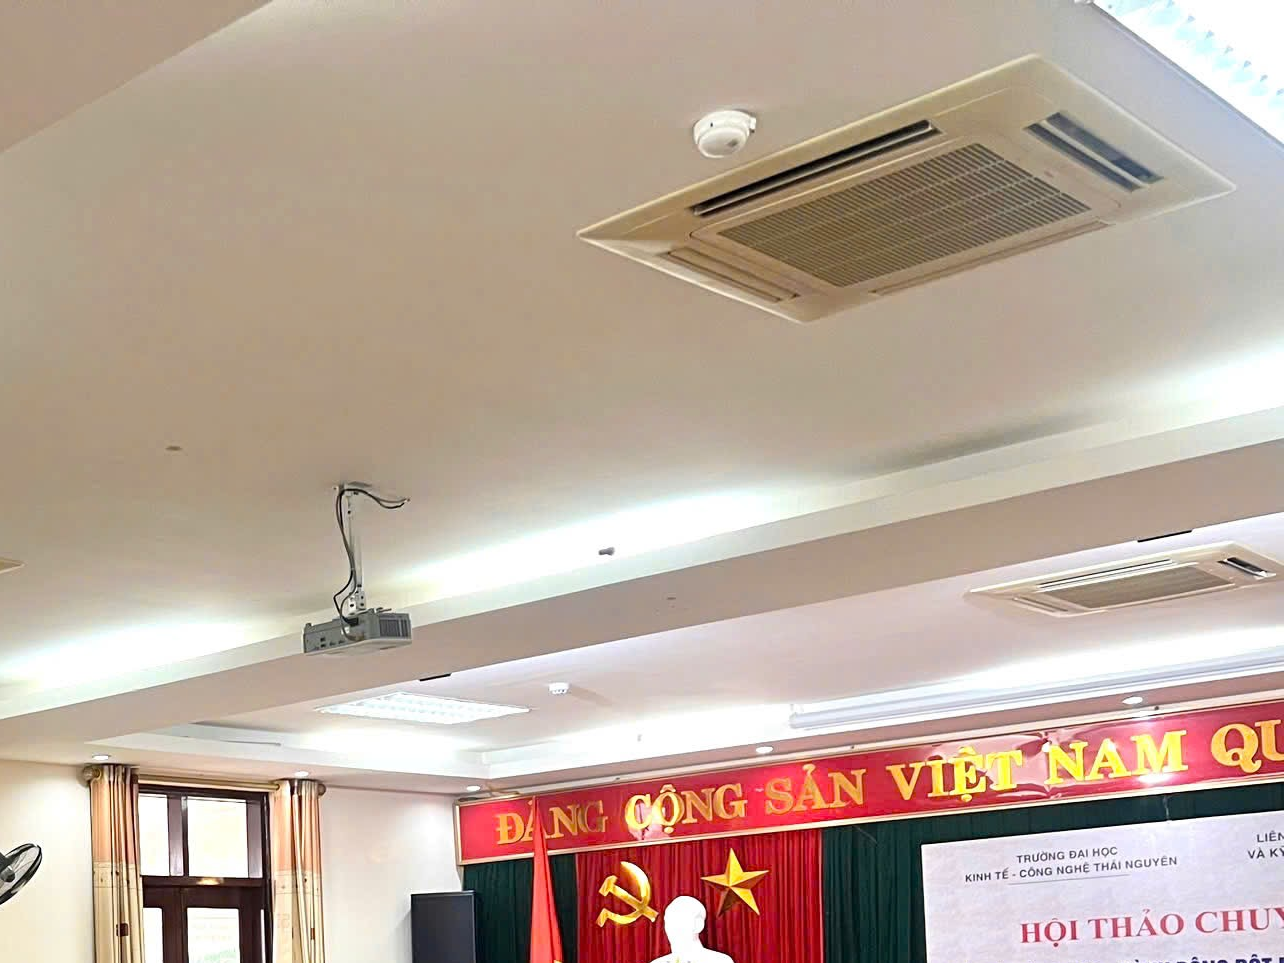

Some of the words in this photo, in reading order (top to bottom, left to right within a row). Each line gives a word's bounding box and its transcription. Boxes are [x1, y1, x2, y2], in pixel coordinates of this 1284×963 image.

[625, 783, 747, 833] CỘNG
[764, 764, 867, 815] SẢN
[885, 746, 1023, 802] VIỆT
[1042, 730, 1189, 785] NAM
[1211, 718, 1284, 774] QU
[1016, 851, 1065, 864] TRƯỜNG
[1093, 846, 1118, 858] HỌC
[1247, 847, 1265, 859] VÀ
[965, 872, 991, 882] KINH
[995, 867, 1009, 879] TẾ
[1019, 867, 1053, 878] CÔNG
[1125, 855, 1177, 869] NGUYÊN
[1020, 917, 1080, 948] HỘI
[1087, 908, 1185, 939] THẢO
